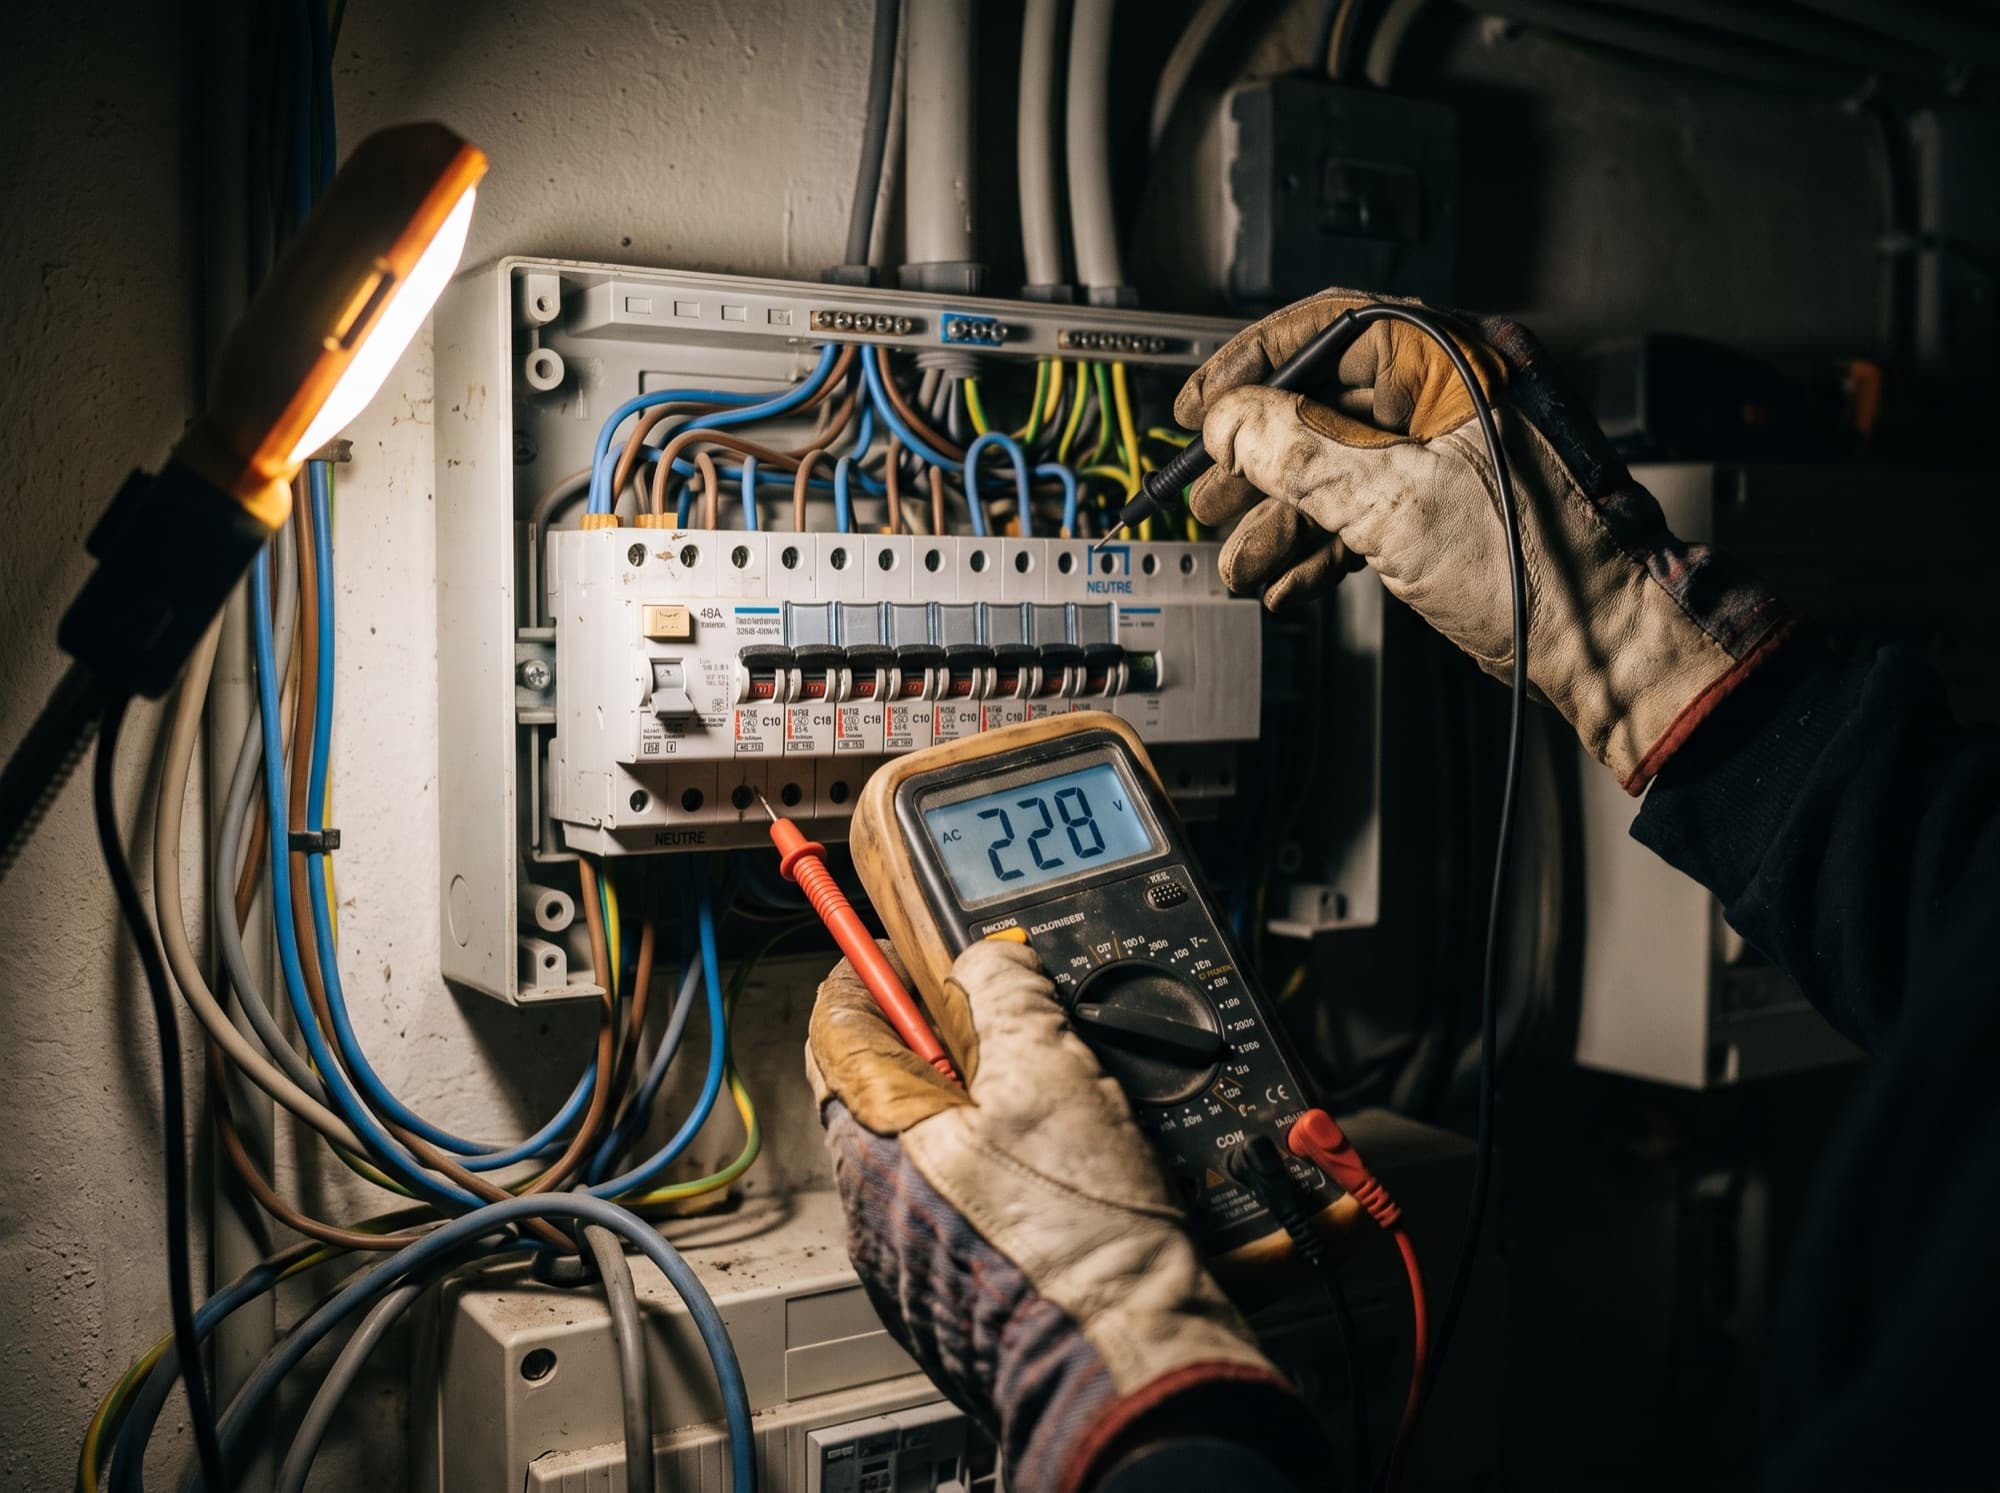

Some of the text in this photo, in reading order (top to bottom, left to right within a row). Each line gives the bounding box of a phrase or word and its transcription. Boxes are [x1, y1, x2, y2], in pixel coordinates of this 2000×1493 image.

[1087, 580, 1132, 594] NEUTRE
[762, 716, 781, 727] C10
[912, 713, 930, 724] C10
[959, 712, 977, 723] C10
[1006, 712, 1023, 722] C10
[654, 830, 705, 846] NEUTRE
[942, 786, 1125, 882] AC 228 V
